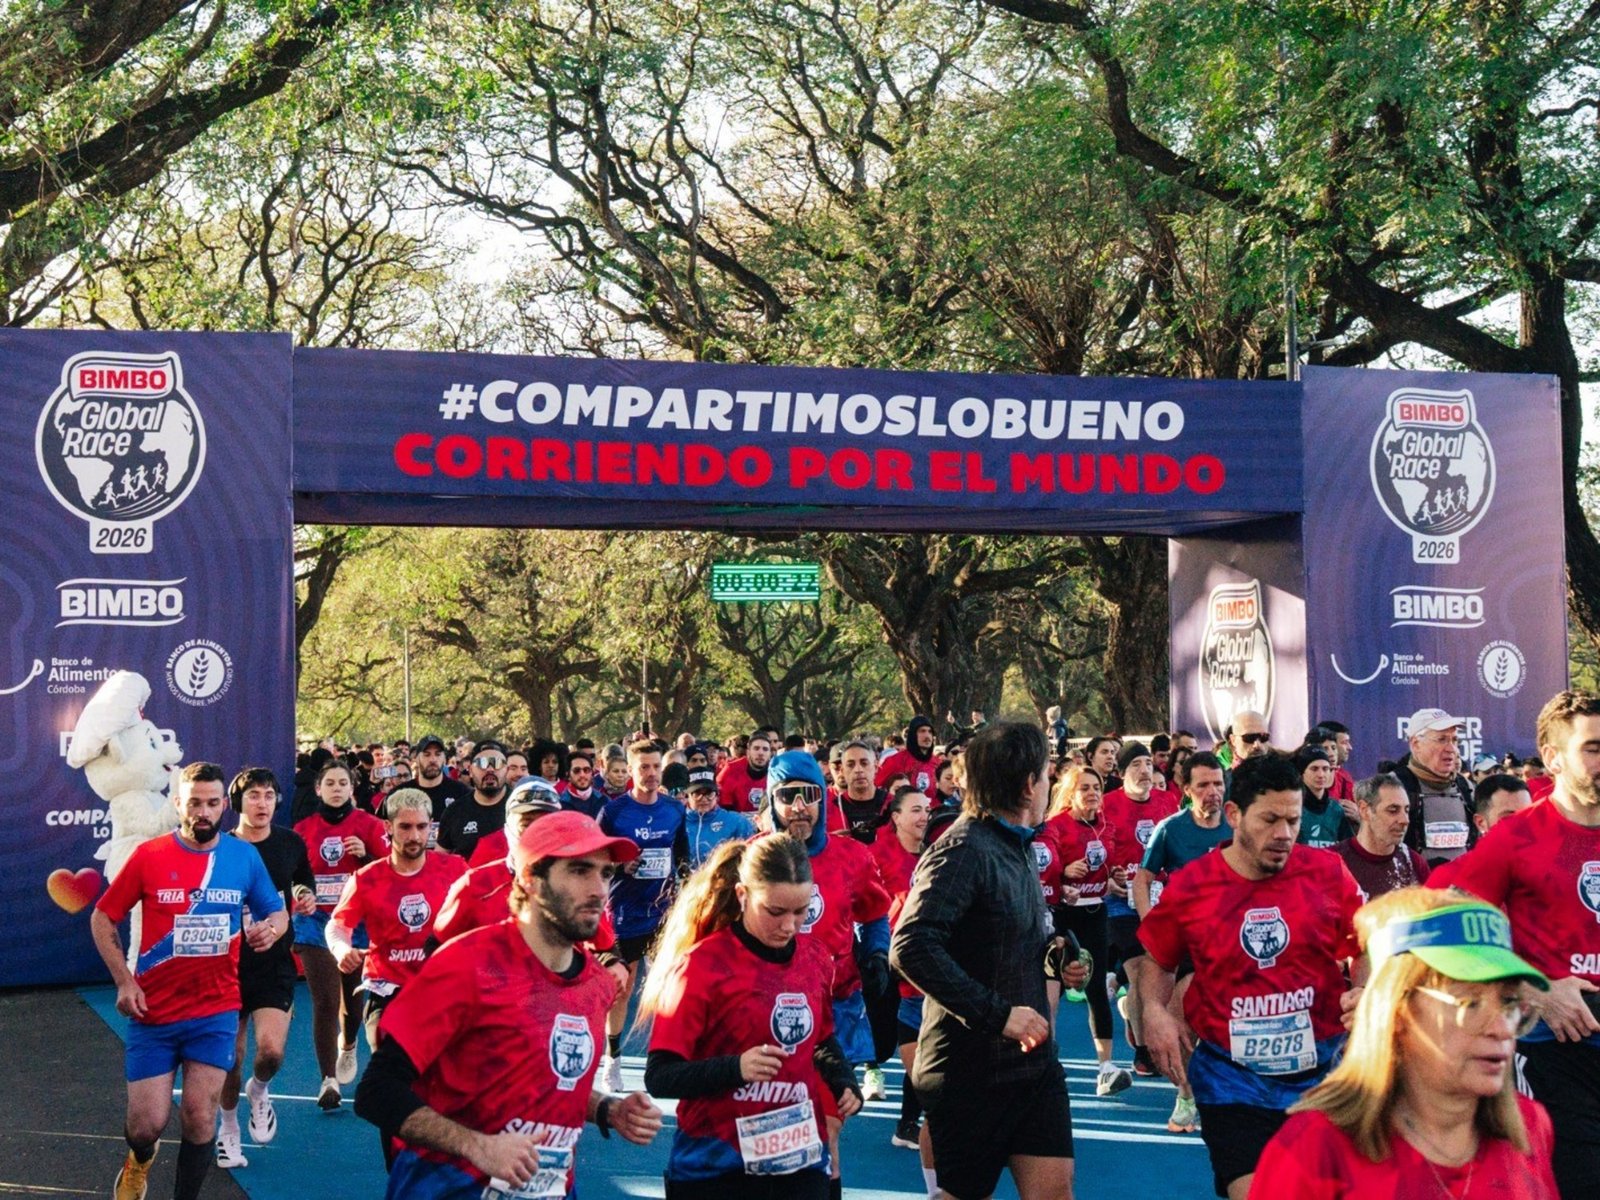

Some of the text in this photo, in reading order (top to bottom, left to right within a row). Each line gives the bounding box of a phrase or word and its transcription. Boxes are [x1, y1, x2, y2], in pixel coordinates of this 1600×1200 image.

[79, 369, 167, 390] BIMBO
[80, 402, 165, 430] Global
[438, 379, 1185, 442] #COMPARTIMOSLOBUENO
[1399, 403, 1465, 422] BIMBO
[61, 427, 132, 456] Race
[1402, 431, 1464, 457] Global
[393, 431, 1226, 495] CORRIENDO POR EL MUNDO
[1389, 456, 1441, 479] Race
[96, 527, 147, 548] 2026
[1417, 541, 1455, 559] 2026
[61, 587, 184, 617] BIMBO
[1216, 598, 1255, 622] BIMBO
[1393, 594, 1484, 619] BIMBO
[166, 639, 233, 669] BANCO DE ALIMENTOS
[1217, 630, 1256, 662] Global
[1393, 653, 1424, 661] Banco de
[51, 656, 93, 666] Banco de
[1391, 661, 1450, 675] Alimentos
[1210, 661, 1240, 689] Race
[47, 684, 86, 694] Córdoba
[157, 890, 185, 902] TRIA
[181, 929, 225, 942] C3045
[1231, 986, 1315, 1018] SANTIAGO
[1244, 1033, 1304, 1057] B2678
